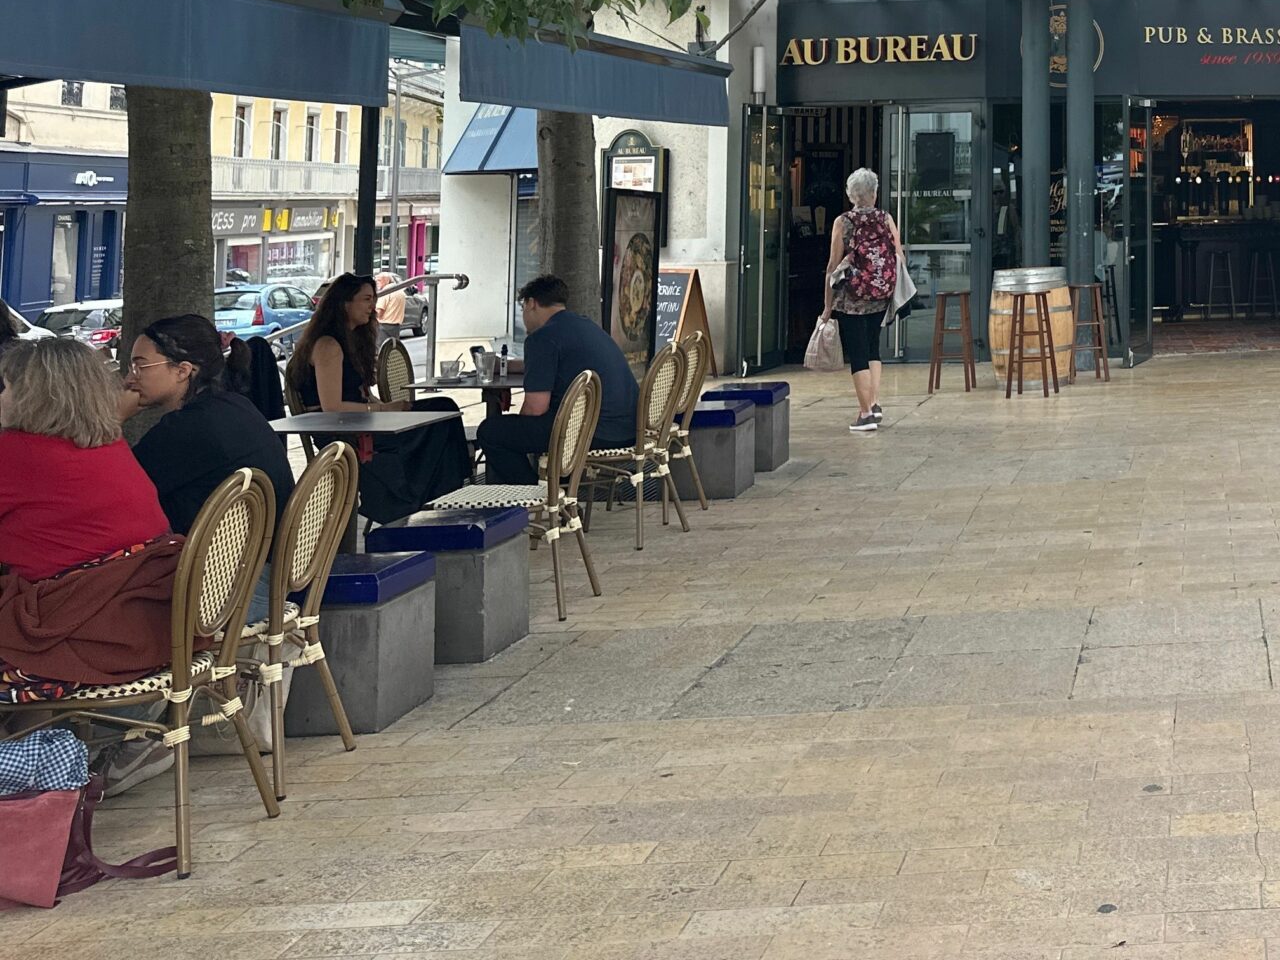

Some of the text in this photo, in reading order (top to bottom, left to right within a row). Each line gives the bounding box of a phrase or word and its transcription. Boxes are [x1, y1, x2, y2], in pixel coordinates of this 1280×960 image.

[1144, 26, 1188, 44] PUB
[1197, 26, 1214, 44] &
[780, 33, 978, 65] AU BUREAU
[1200, 53, 1237, 65] since
[212, 212, 257, 233] CESS pro
[293, 209, 323, 228] immobilier
